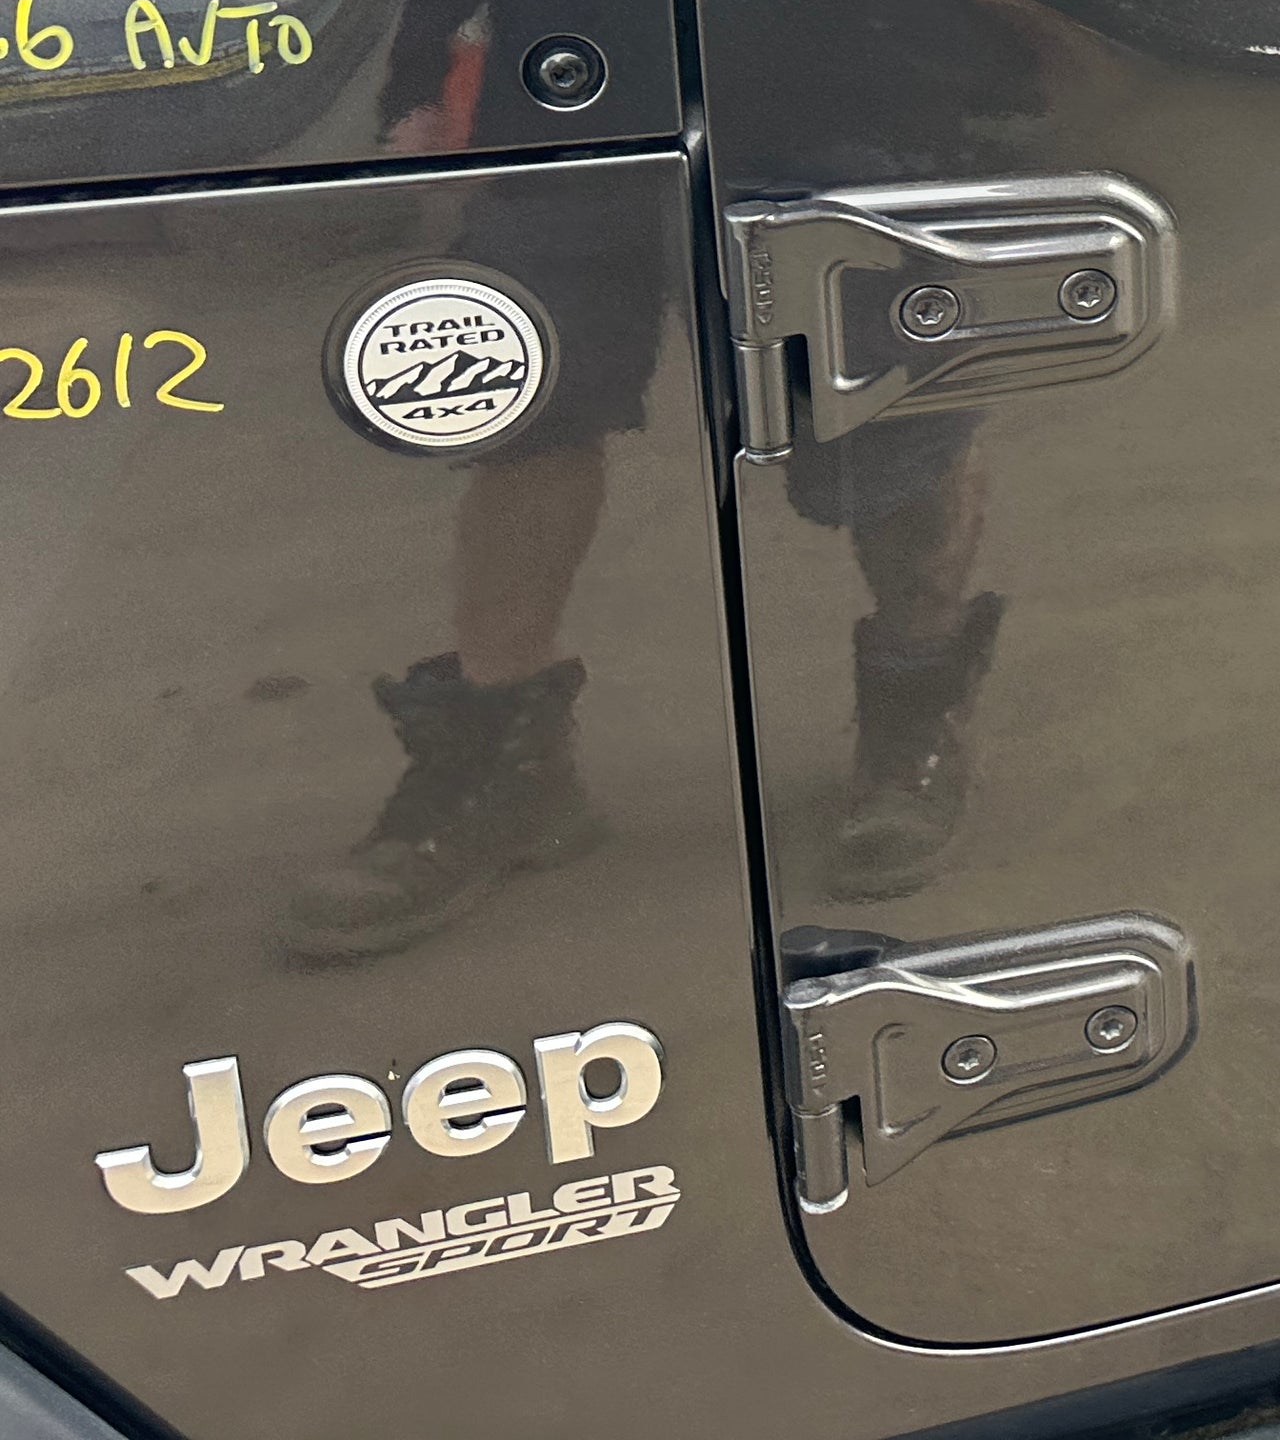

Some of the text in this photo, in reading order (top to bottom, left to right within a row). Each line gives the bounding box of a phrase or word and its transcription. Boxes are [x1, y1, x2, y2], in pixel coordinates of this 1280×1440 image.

[379, 329, 505, 356] RATED
[383, 315, 495, 338] TRAIL
[0, 330, 225, 419] 2612
[401, 398, 497, 420] 4x4
[95, 1020, 664, 1215] Jeep
[125, 1164, 681, 1300] WRANGLER
[340, 1194, 681, 1288] SPORT
